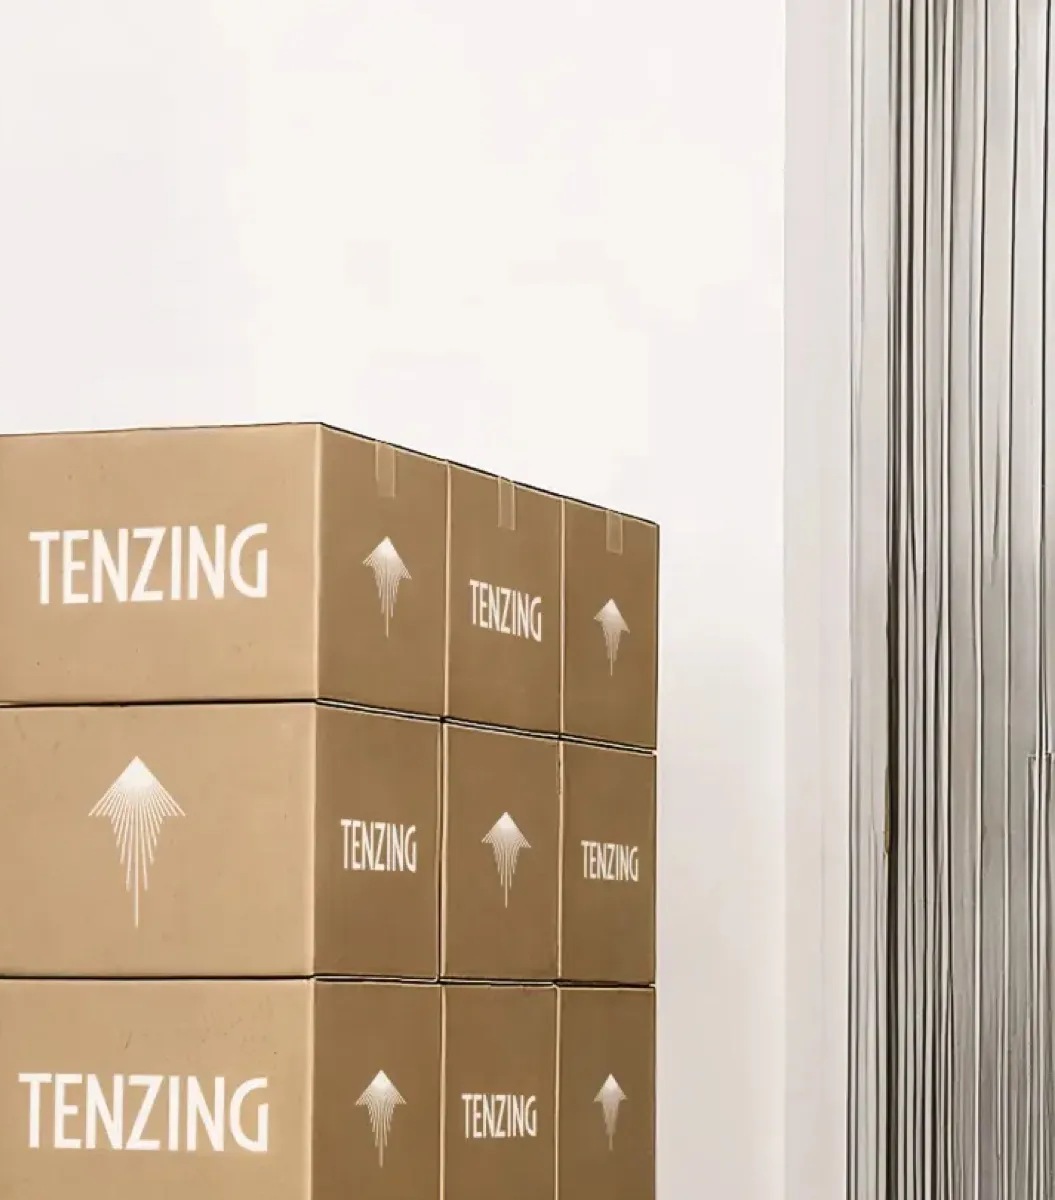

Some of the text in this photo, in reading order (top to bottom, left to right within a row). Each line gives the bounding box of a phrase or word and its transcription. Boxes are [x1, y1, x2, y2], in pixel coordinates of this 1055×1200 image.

[29, 522, 268, 605] TENZING
[469, 579, 542, 642] TENZING
[340, 818, 417, 873] TENZING
[580, 840, 639, 882] TENZING
[18, 1072, 269, 1153] TENZING
[461, 1093, 537, 1139] TENZING
